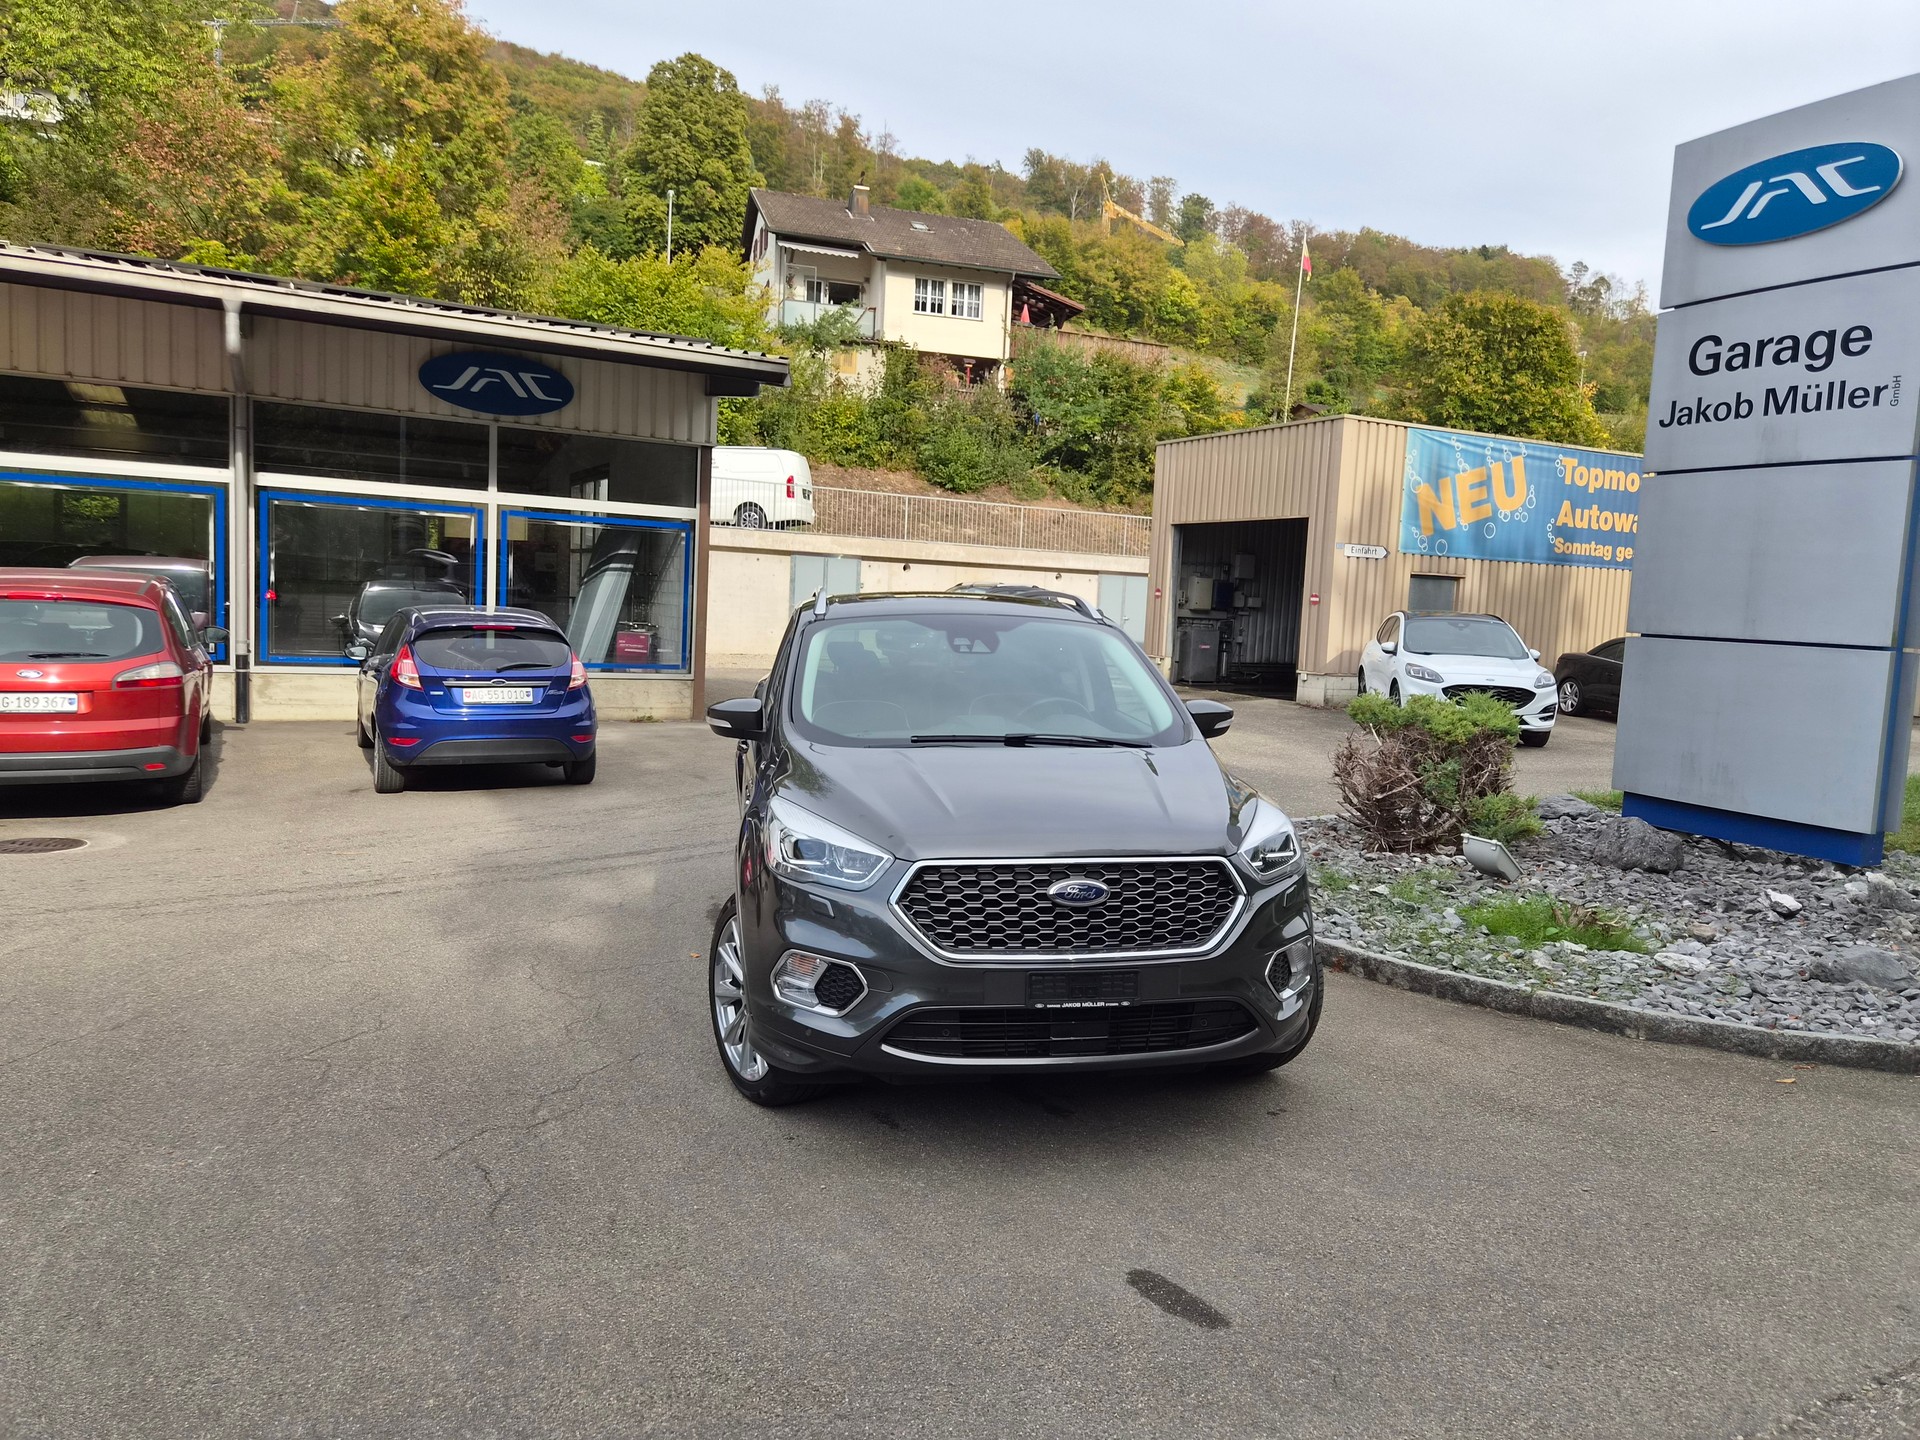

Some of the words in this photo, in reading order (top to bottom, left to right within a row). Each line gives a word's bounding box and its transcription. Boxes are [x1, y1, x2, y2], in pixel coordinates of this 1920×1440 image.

[1688, 323, 1873, 377] Garage
[1658, 391, 1754, 428] Jakob
[1762, 380, 1889, 417] Müller
[1889, 375, 1902, 407] GmbH
[1561, 457, 1640, 493] Topmo
[1416, 455, 1527, 537] NEU
[1351, 545, 1378, 556] Einfahrt
[1554, 537, 1613, 561] Sonntag
[1064, 885, 1096, 899] Ford
